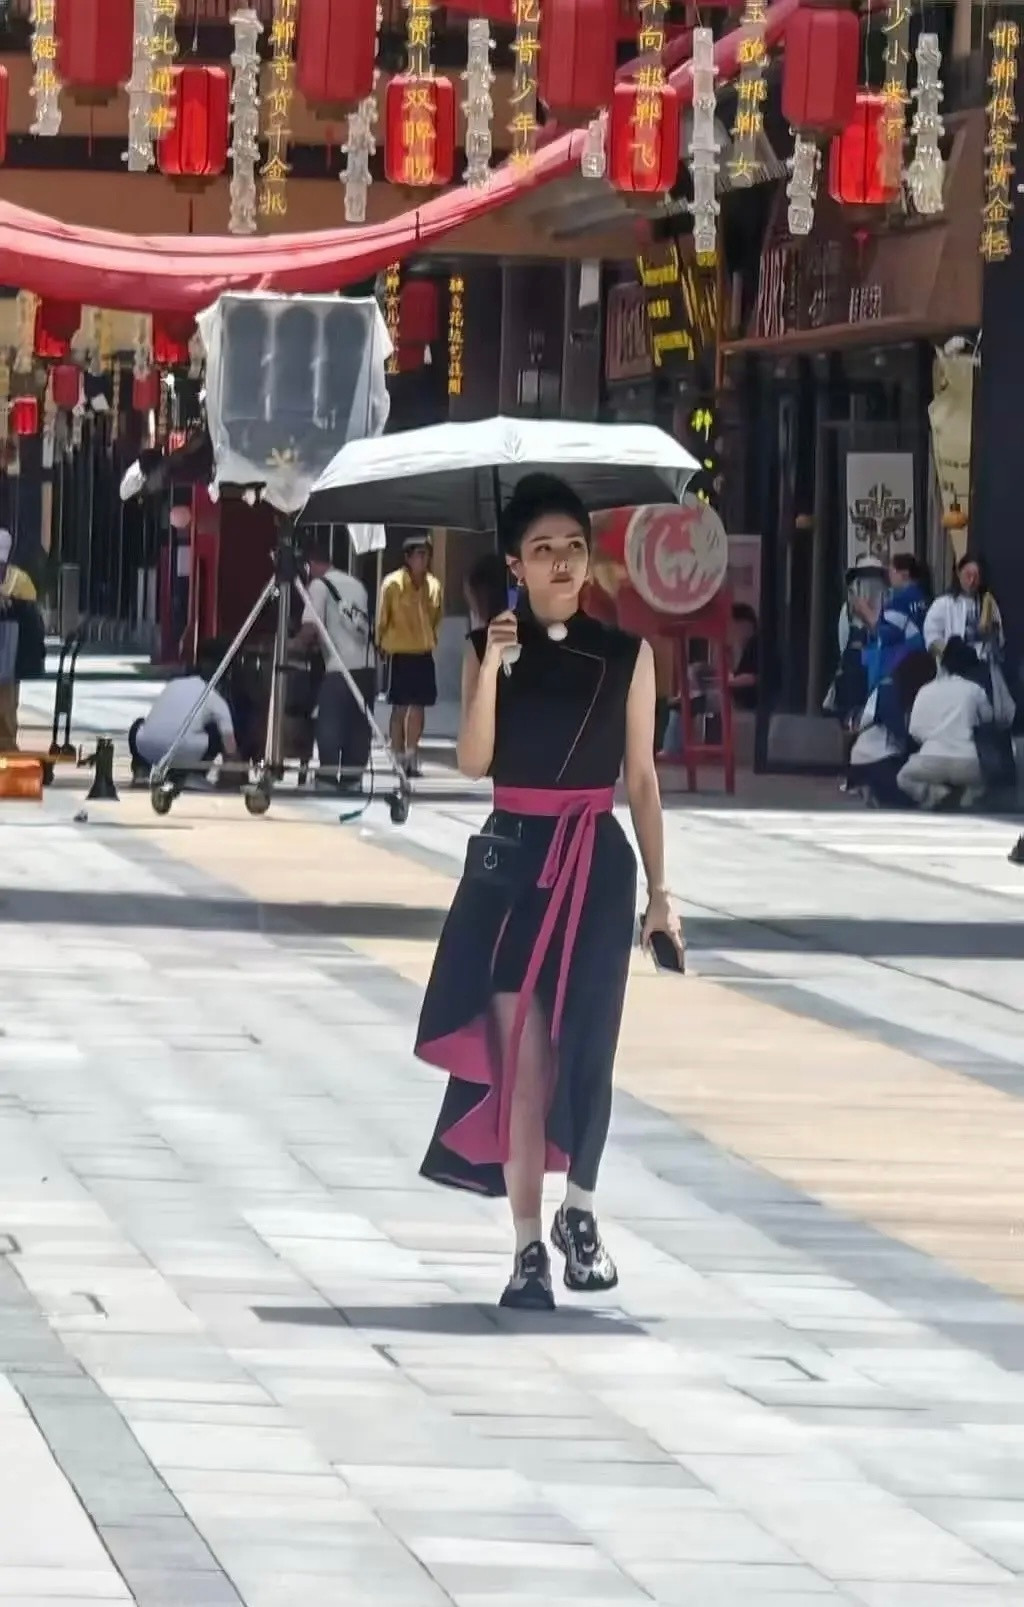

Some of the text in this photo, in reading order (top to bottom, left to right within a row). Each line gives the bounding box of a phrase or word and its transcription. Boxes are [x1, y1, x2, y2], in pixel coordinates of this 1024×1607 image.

[260, 0, 296, 214] 郸奇货千金
[508, 0, 541, 174] 忆昔少年
